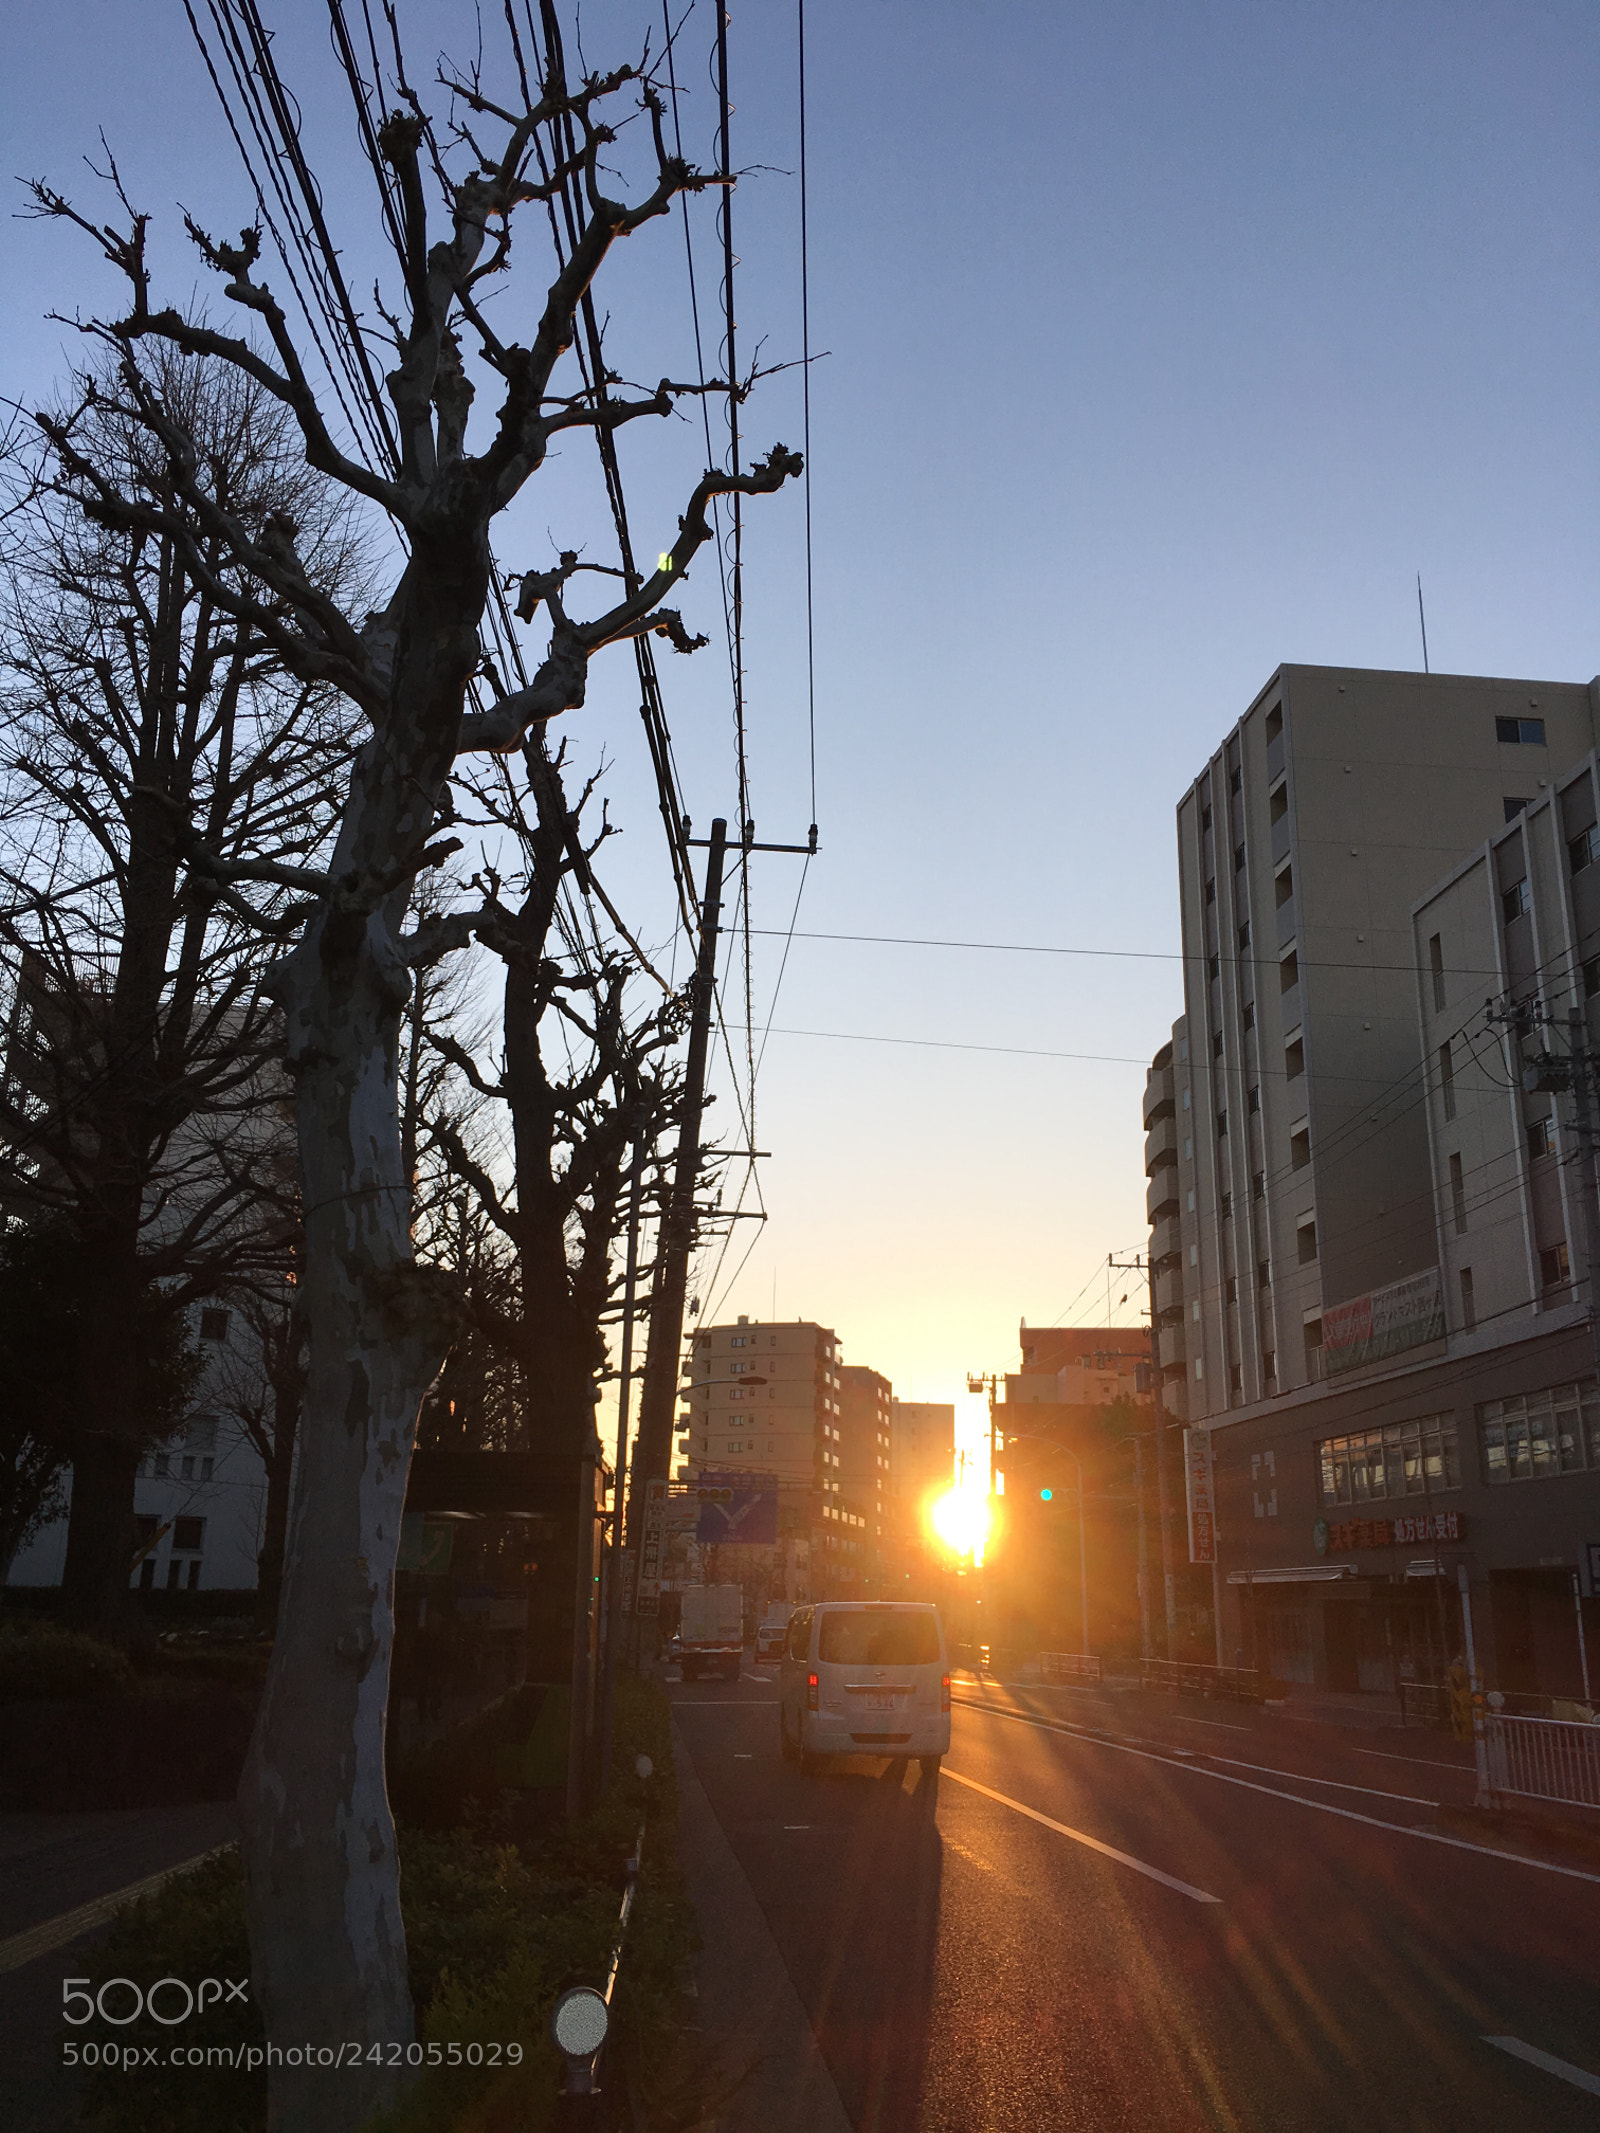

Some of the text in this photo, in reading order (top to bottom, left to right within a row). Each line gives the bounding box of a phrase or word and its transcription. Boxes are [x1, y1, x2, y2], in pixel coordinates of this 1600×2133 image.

[1192, 1451, 1209, 1510] スギ薬局
[1196, 1513, 1211, 1560] 処方せん
